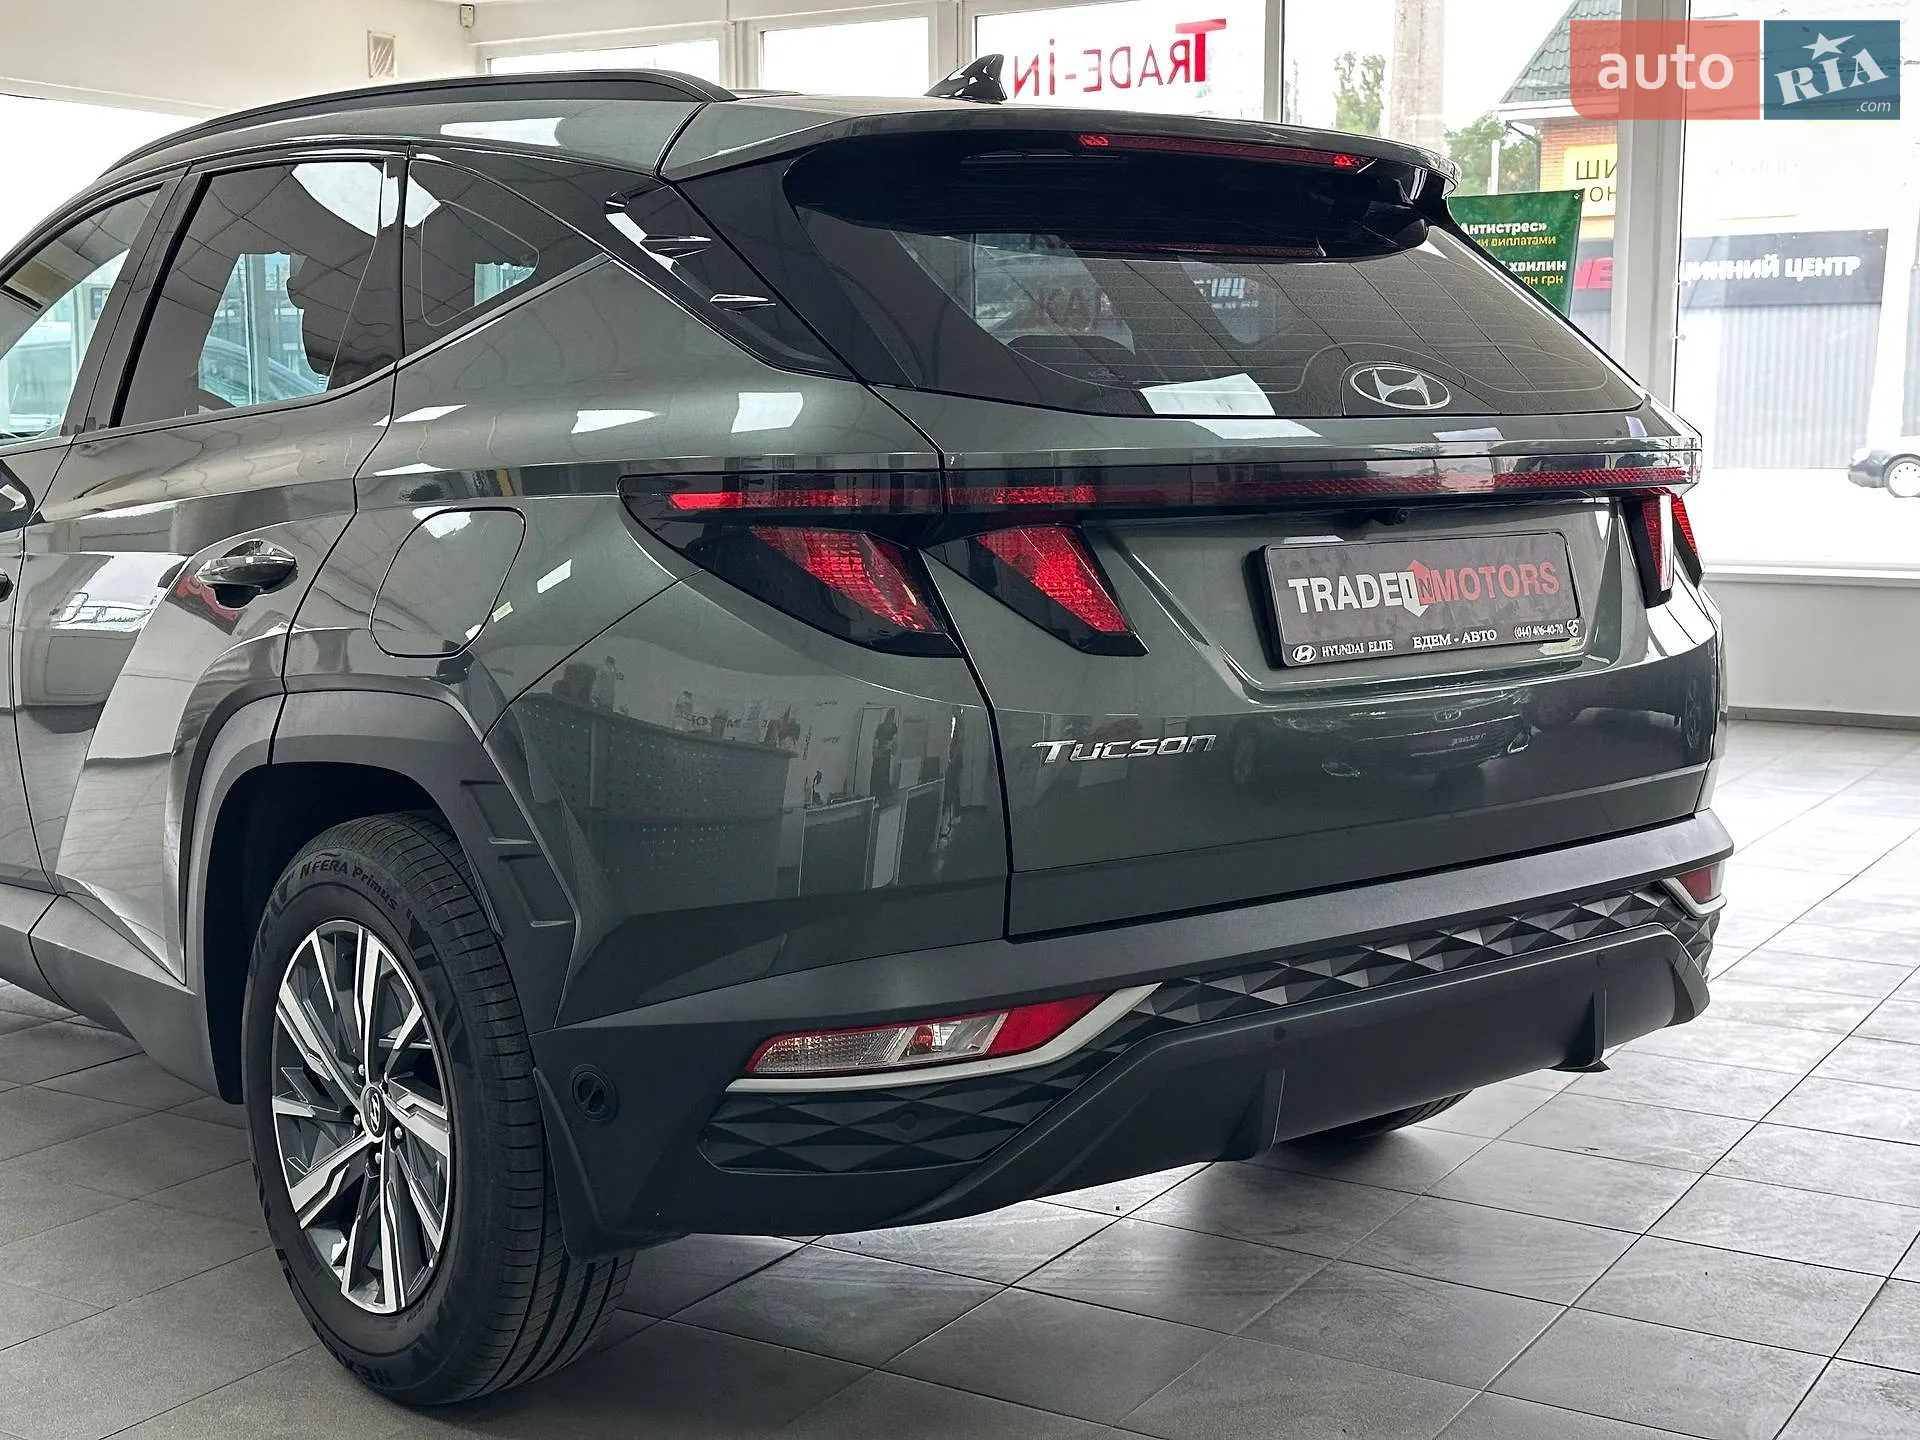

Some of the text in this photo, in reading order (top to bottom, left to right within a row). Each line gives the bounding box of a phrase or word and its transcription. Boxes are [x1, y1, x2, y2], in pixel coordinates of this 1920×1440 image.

[1784, 256, 1861, 282] ЦЕНТР
[1540, 275, 1564, 286] грн
[1321, 639, 1394, 657] HYUNDAI ELITE
[1031, 734, 1217, 764] Tucson
